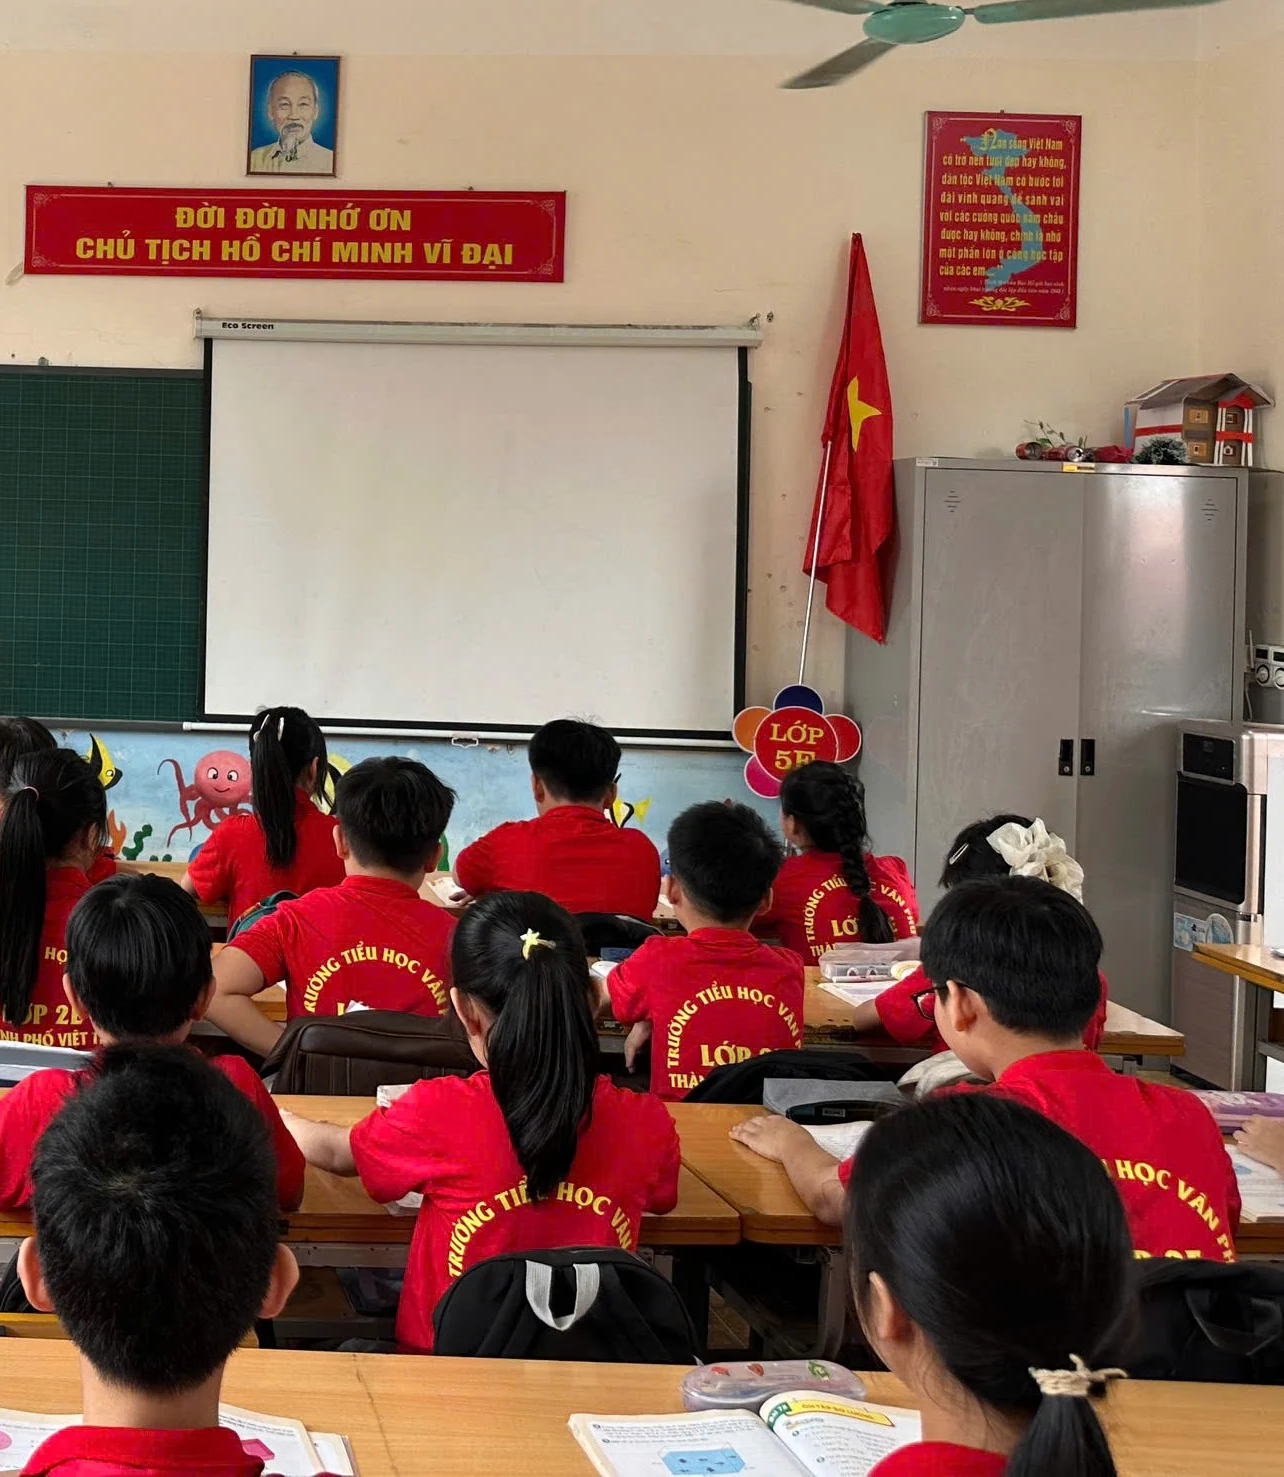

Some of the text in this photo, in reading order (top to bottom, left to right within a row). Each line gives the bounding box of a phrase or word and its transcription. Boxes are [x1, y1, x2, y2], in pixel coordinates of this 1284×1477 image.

[1028, 137, 1044, 152] Việt
[1045, 138, 1063, 150] Nam
[942, 154, 953, 166] có
[955, 152, 967, 166] trở
[968, 154, 984, 166] nên
[1022, 155, 1037, 169] hay
[941, 173, 1064, 188] dân tộc Việt Nam có bước tới
[940, 191, 955, 204] đài
[958, 192, 978, 204] vinh
[980, 193, 1009, 206] quang
[1025, 193, 1047, 206] sánh
[1050, 193, 1064, 206] vai
[175, 201, 412, 231] ĐỜI ĐỜI NHỚ ƠN
[939, 209, 1064, 225] với các cường quốc năm châu
[940, 228, 961, 242] được
[963, 229, 978, 242] hay
[1010, 229, 1034, 241] chính
[1035, 230, 1043, 242] là
[1045, 230, 1061, 243] nhờ
[75, 229, 513, 269] CHỦ TỊCH HỒ CHÍ MINH VĨ ĐẠI
[939, 246, 956, 260] một
[958, 244, 980, 260] phần
[982, 247, 996, 259] lớn
[1006, 248, 1028, 261] công
[1031, 248, 1047, 262] học
[1049, 248, 1064, 264] tập
[939, 261, 954, 276] của
[956, 264, 971, 276] các
[241, 322, 274, 330] Screen
[770, 720, 824, 744] LỚP
[804, 888, 825, 943] TRƯỜNG
[821, 873, 848, 892] TIỂU
[880, 884, 905, 908] VÂN
[830, 914, 860, 937] LỚ
[45, 946, 68, 965] HỌ
[303, 957, 341, 1013] RƯỜNG
[341, 941, 377, 965] TIỂU
[382, 947, 421, 974] HỌC
[421, 968, 448, 1005] VÂN
[667, 980, 802, 1069] TRƯỜNG TIỂU HỌC VÂN
[23, 1028, 54, 1047] PHỐ
[57, 1029, 88, 1047] VIỆT
[700, 1040, 752, 1067] LỚP
[668, 1071, 704, 1089] THÀ
[1115, 1159, 1171, 1190] HỌC
[1176, 1178, 1220, 1231] VÂN
[448, 1175, 632, 1278] TRƯỜNG TIỂ HỌC VÂN
